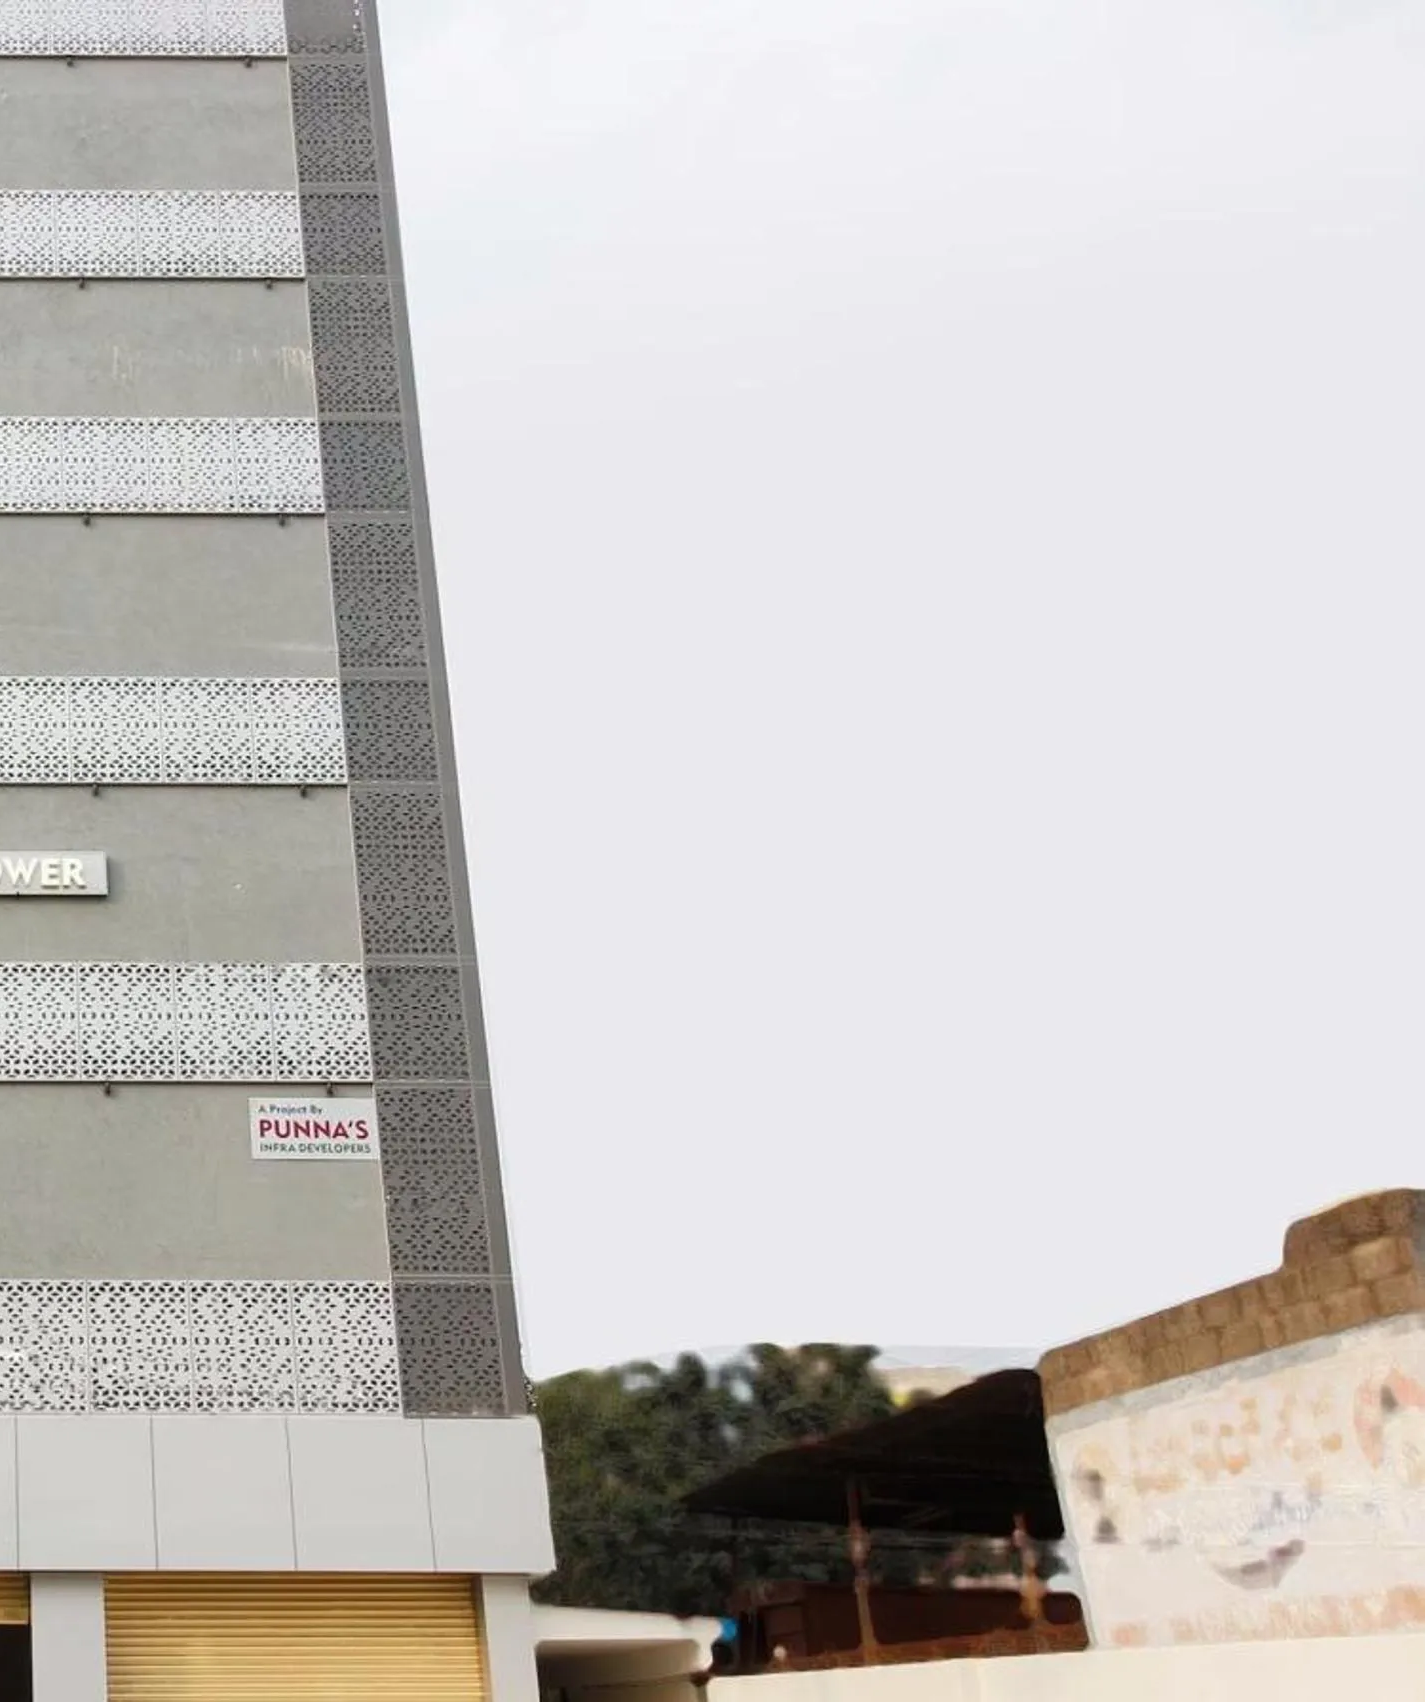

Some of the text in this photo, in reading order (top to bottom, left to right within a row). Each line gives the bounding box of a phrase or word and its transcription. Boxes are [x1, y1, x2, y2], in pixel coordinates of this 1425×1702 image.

[258, 1103, 267, 1113] A
[269, 1103, 308, 1116] Project
[259, 1119, 370, 1140] PUNNA'S
[259, 1142, 372, 1154] INFRA DEVELOPERS
